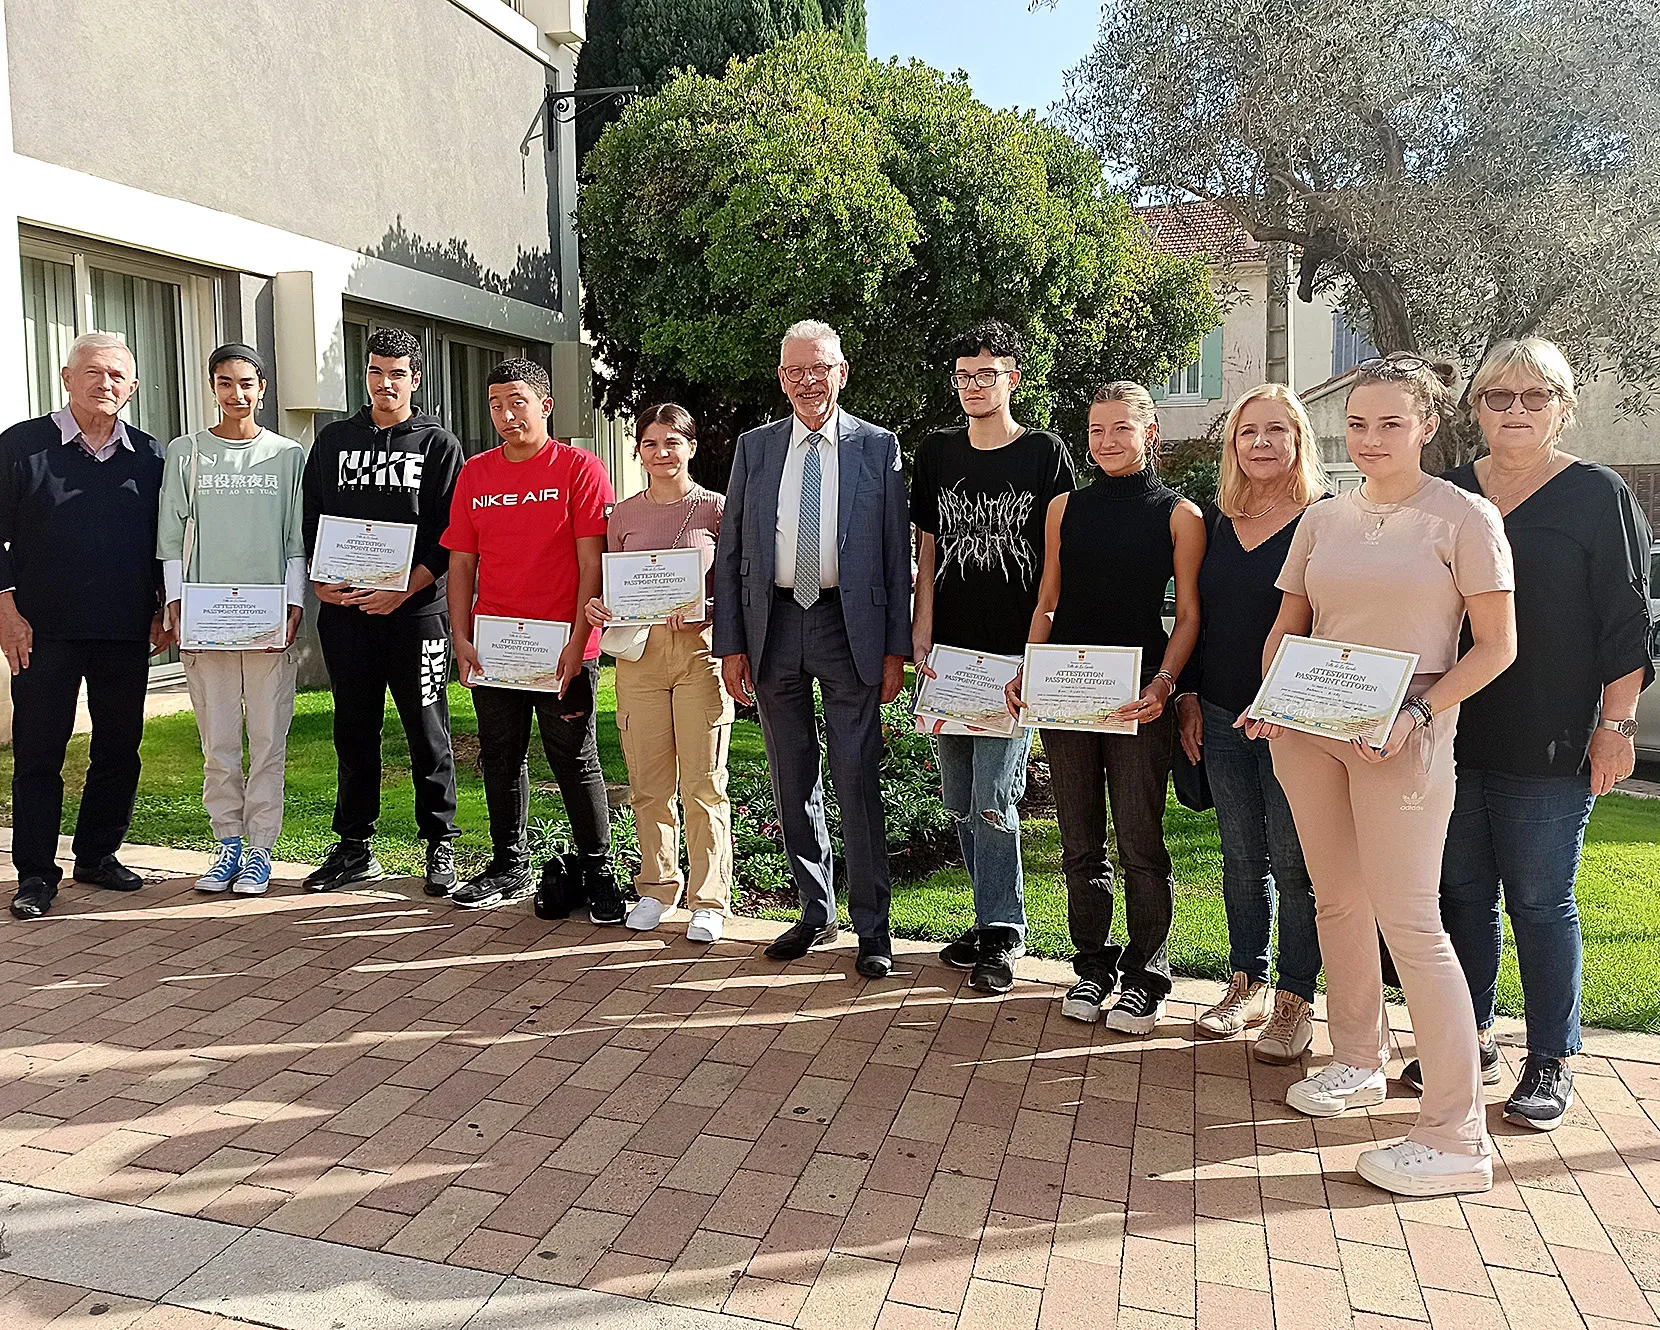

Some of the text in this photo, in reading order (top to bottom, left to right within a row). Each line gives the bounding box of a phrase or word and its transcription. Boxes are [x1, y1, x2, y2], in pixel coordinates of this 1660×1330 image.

[338, 450, 424, 489] NIKE
[198, 474, 278, 489] 退役熬夜员
[472, 488, 559, 510] NIKE AIR
[632, 571, 675, 580] ATTESTATION
[658, 577, 686, 585] CITOYEN
[954, 670, 996, 682] ATTESTATION
[1055, 670, 1105, 678] ATTESTATION
[1309, 667, 1367, 682] ATTESTATION
[1084, 677, 1116, 686] CITOYEN
[1340, 678, 1378, 693] CITOYEN
